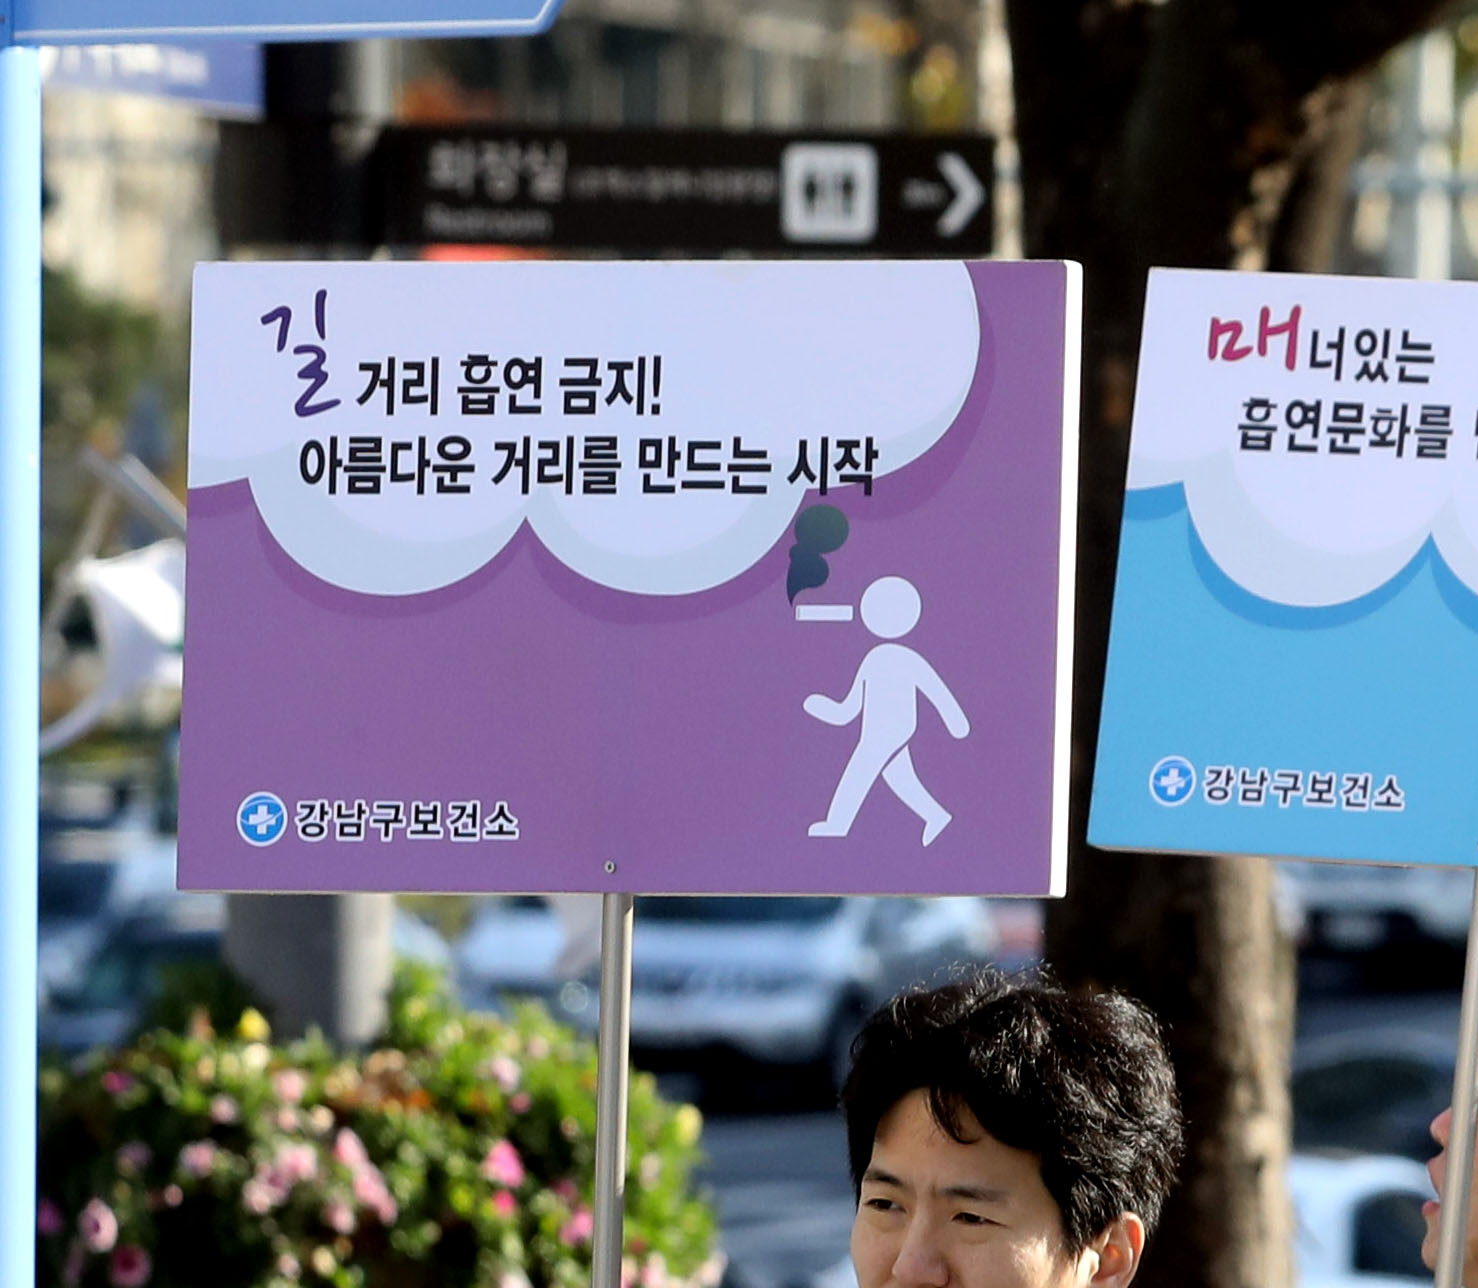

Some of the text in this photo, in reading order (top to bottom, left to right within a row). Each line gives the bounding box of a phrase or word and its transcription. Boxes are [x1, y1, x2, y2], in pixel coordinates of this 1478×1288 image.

[456, 355, 545, 416] 흡연
[559, 355, 663, 416] 금지!
[1236, 397, 1454, 460] 흡연문화를
[299, 436, 880, 496] 아름다운 거리를 만드는 시작
[1203, 766, 1406, 811] 강남구보건소
[294, 798, 520, 841] 강남구보건소
